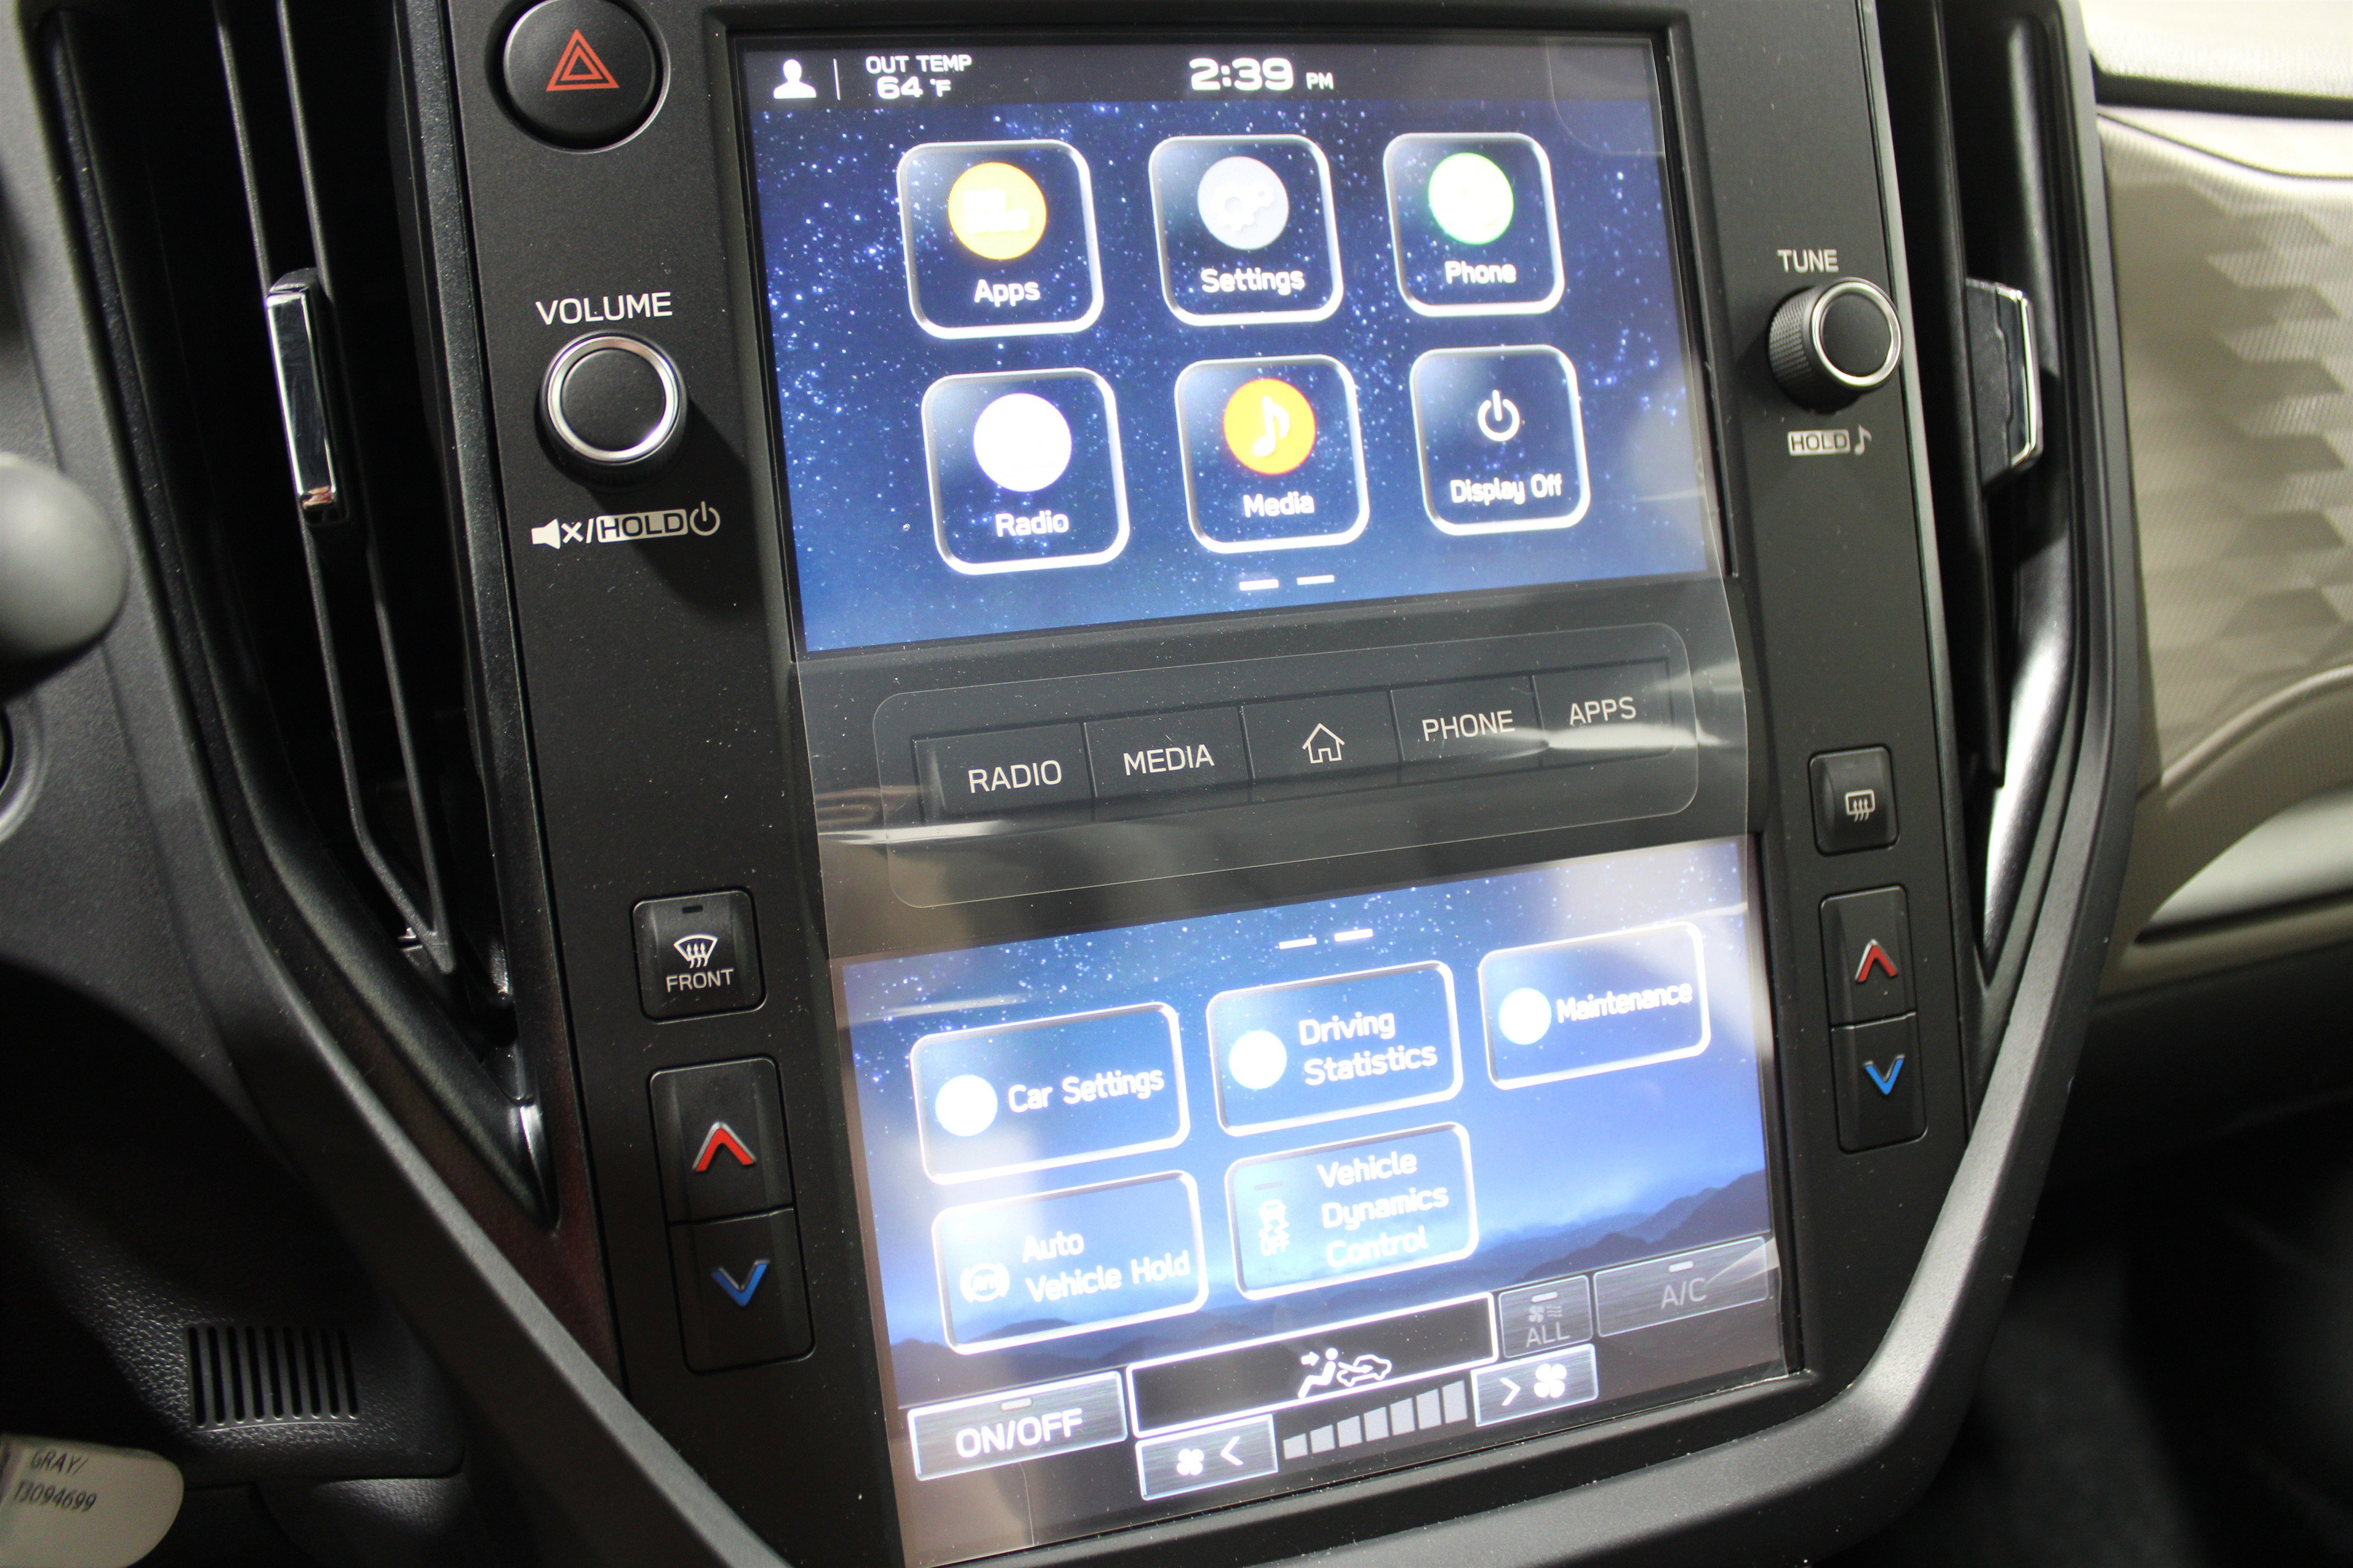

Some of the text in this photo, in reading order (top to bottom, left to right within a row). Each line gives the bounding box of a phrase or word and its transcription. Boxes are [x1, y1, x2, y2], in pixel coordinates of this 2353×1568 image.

[866, 55, 972, 74] OUT TEMP
[1189, 58, 1334, 91] 2:39 PM
[877, 76, 923, 99] 64
[1445, 260, 1517, 285] Phone
[1777, 249, 1838, 273] TUNE
[974, 279, 1041, 307] Apps
[1201, 268, 1305, 296] Settings
[535, 292, 673, 325] VOLUME
[1790, 432, 1848, 453] HOLD
[1243, 492, 1316, 518] Media
[1449, 473, 1564, 505] Display Off
[599, 514, 685, 540] HOLD
[995, 510, 1070, 538] Radio
[1422, 708, 1515, 743] PHONE
[1568, 696, 1637, 725] APPS
[1123, 744, 1214, 776] MEDIA
[967, 759, 1063, 795] RADIO
[666, 968, 734, 992] FRONT
[1556, 982, 1693, 1023] Maintenance
[1299, 1010, 1396, 1046] Driving
[1303, 1044, 1438, 1086] Statistics
[1007, 1068, 1165, 1113] Car Settings
[1317, 1150, 1417, 1188] Vehicle
[1321, 1187, 1449, 1231] Dynamics
[1021, 1230, 1085, 1264] Auto
[1326, 1226, 1429, 1267] Control
[1025, 1266, 1123, 1303] Vehicle
[1131, 1250, 1191, 1282] Hold
[1660, 1277, 1707, 1309] A/C
[1525, 1324, 1571, 1348] ALL
[957, 1409, 1083, 1457] ON/OFF
